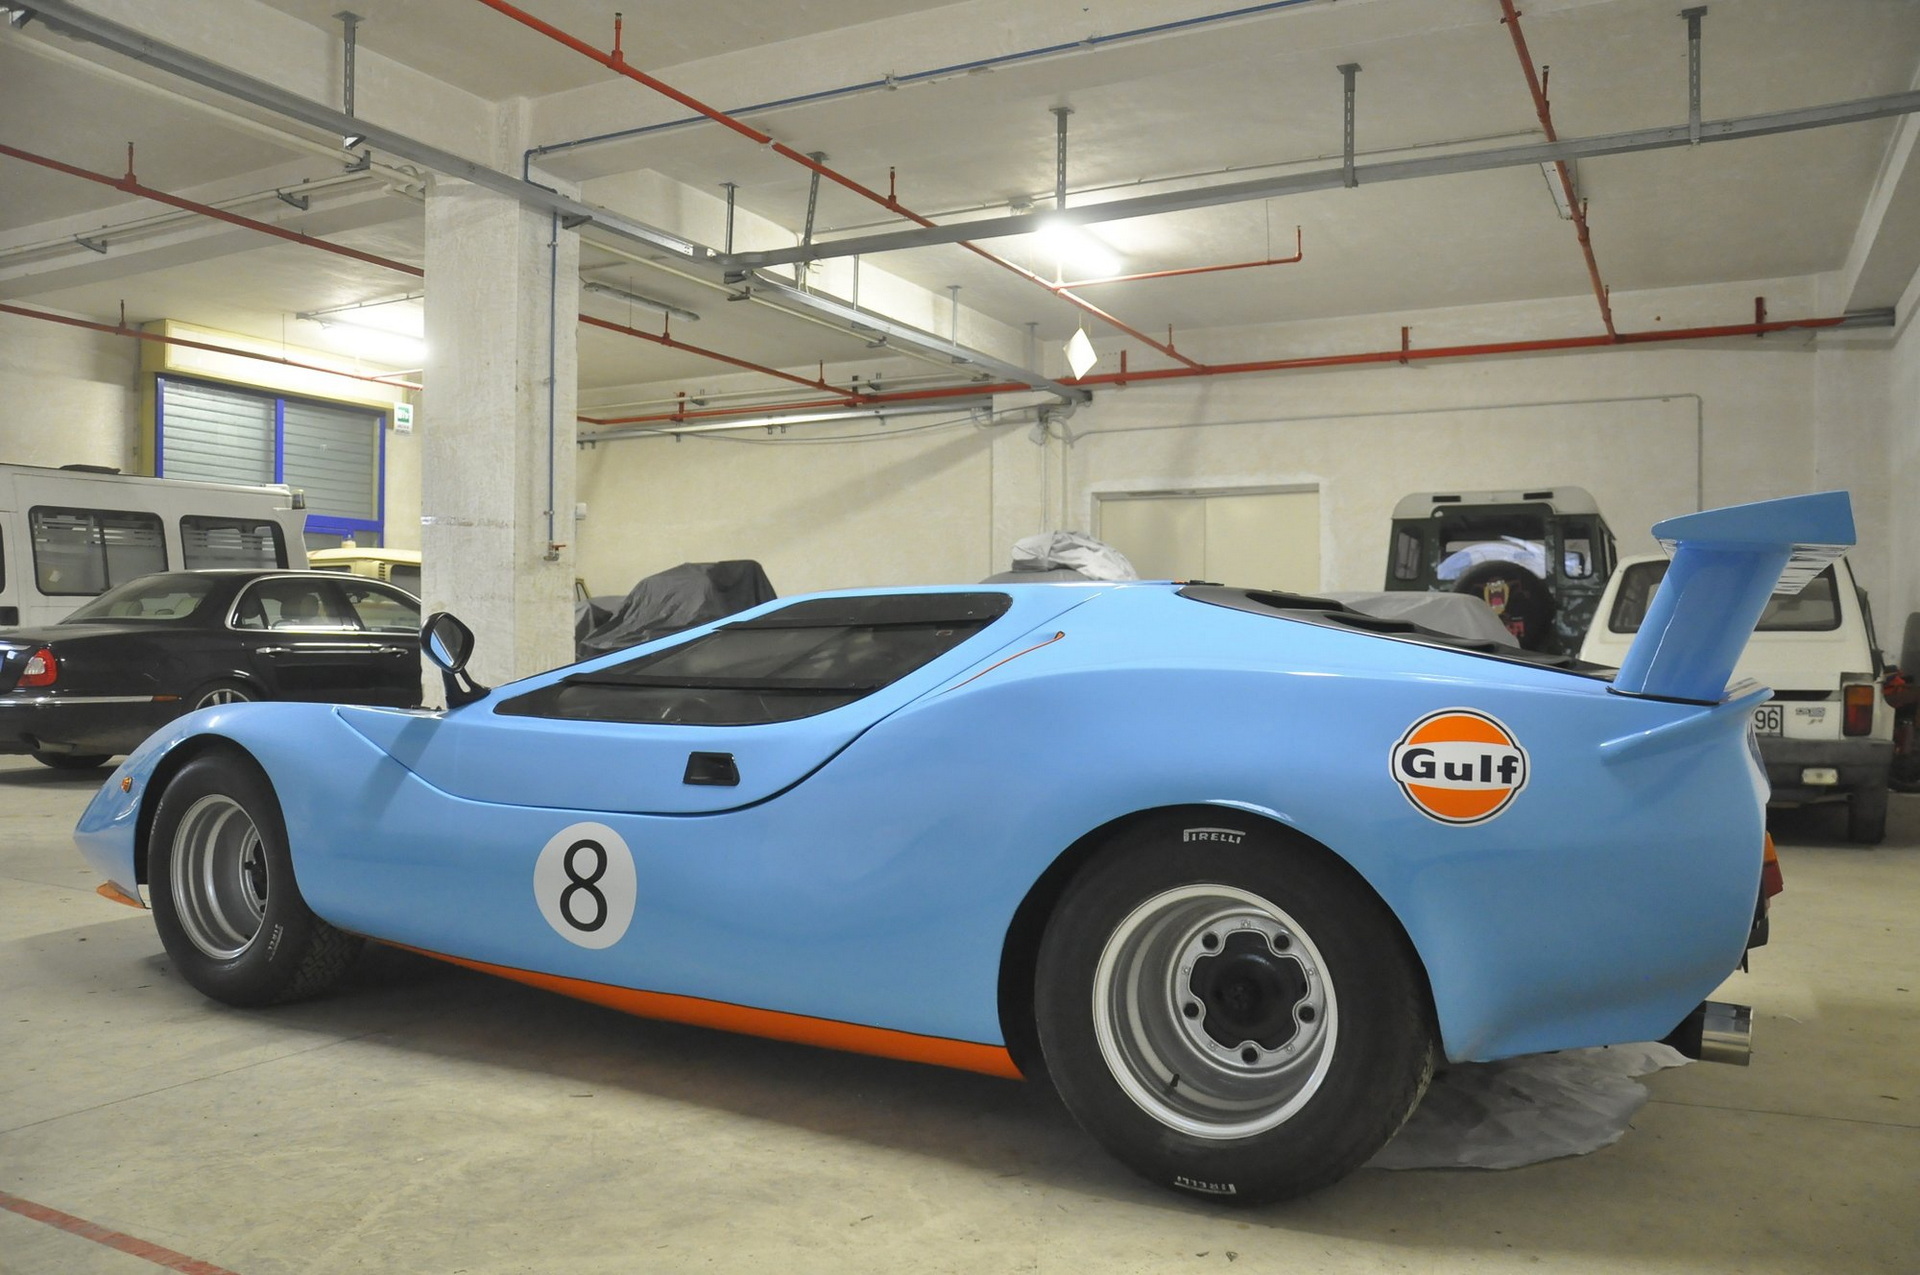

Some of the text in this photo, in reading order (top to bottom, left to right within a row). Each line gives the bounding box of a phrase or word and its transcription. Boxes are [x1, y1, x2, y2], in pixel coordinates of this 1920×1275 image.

[1755, 709, 1779, 730] 96
[1401, 748, 1519, 784] Gulf
[1183, 827, 1246, 844] PIRELLI
[560, 838, 607, 932] 8
